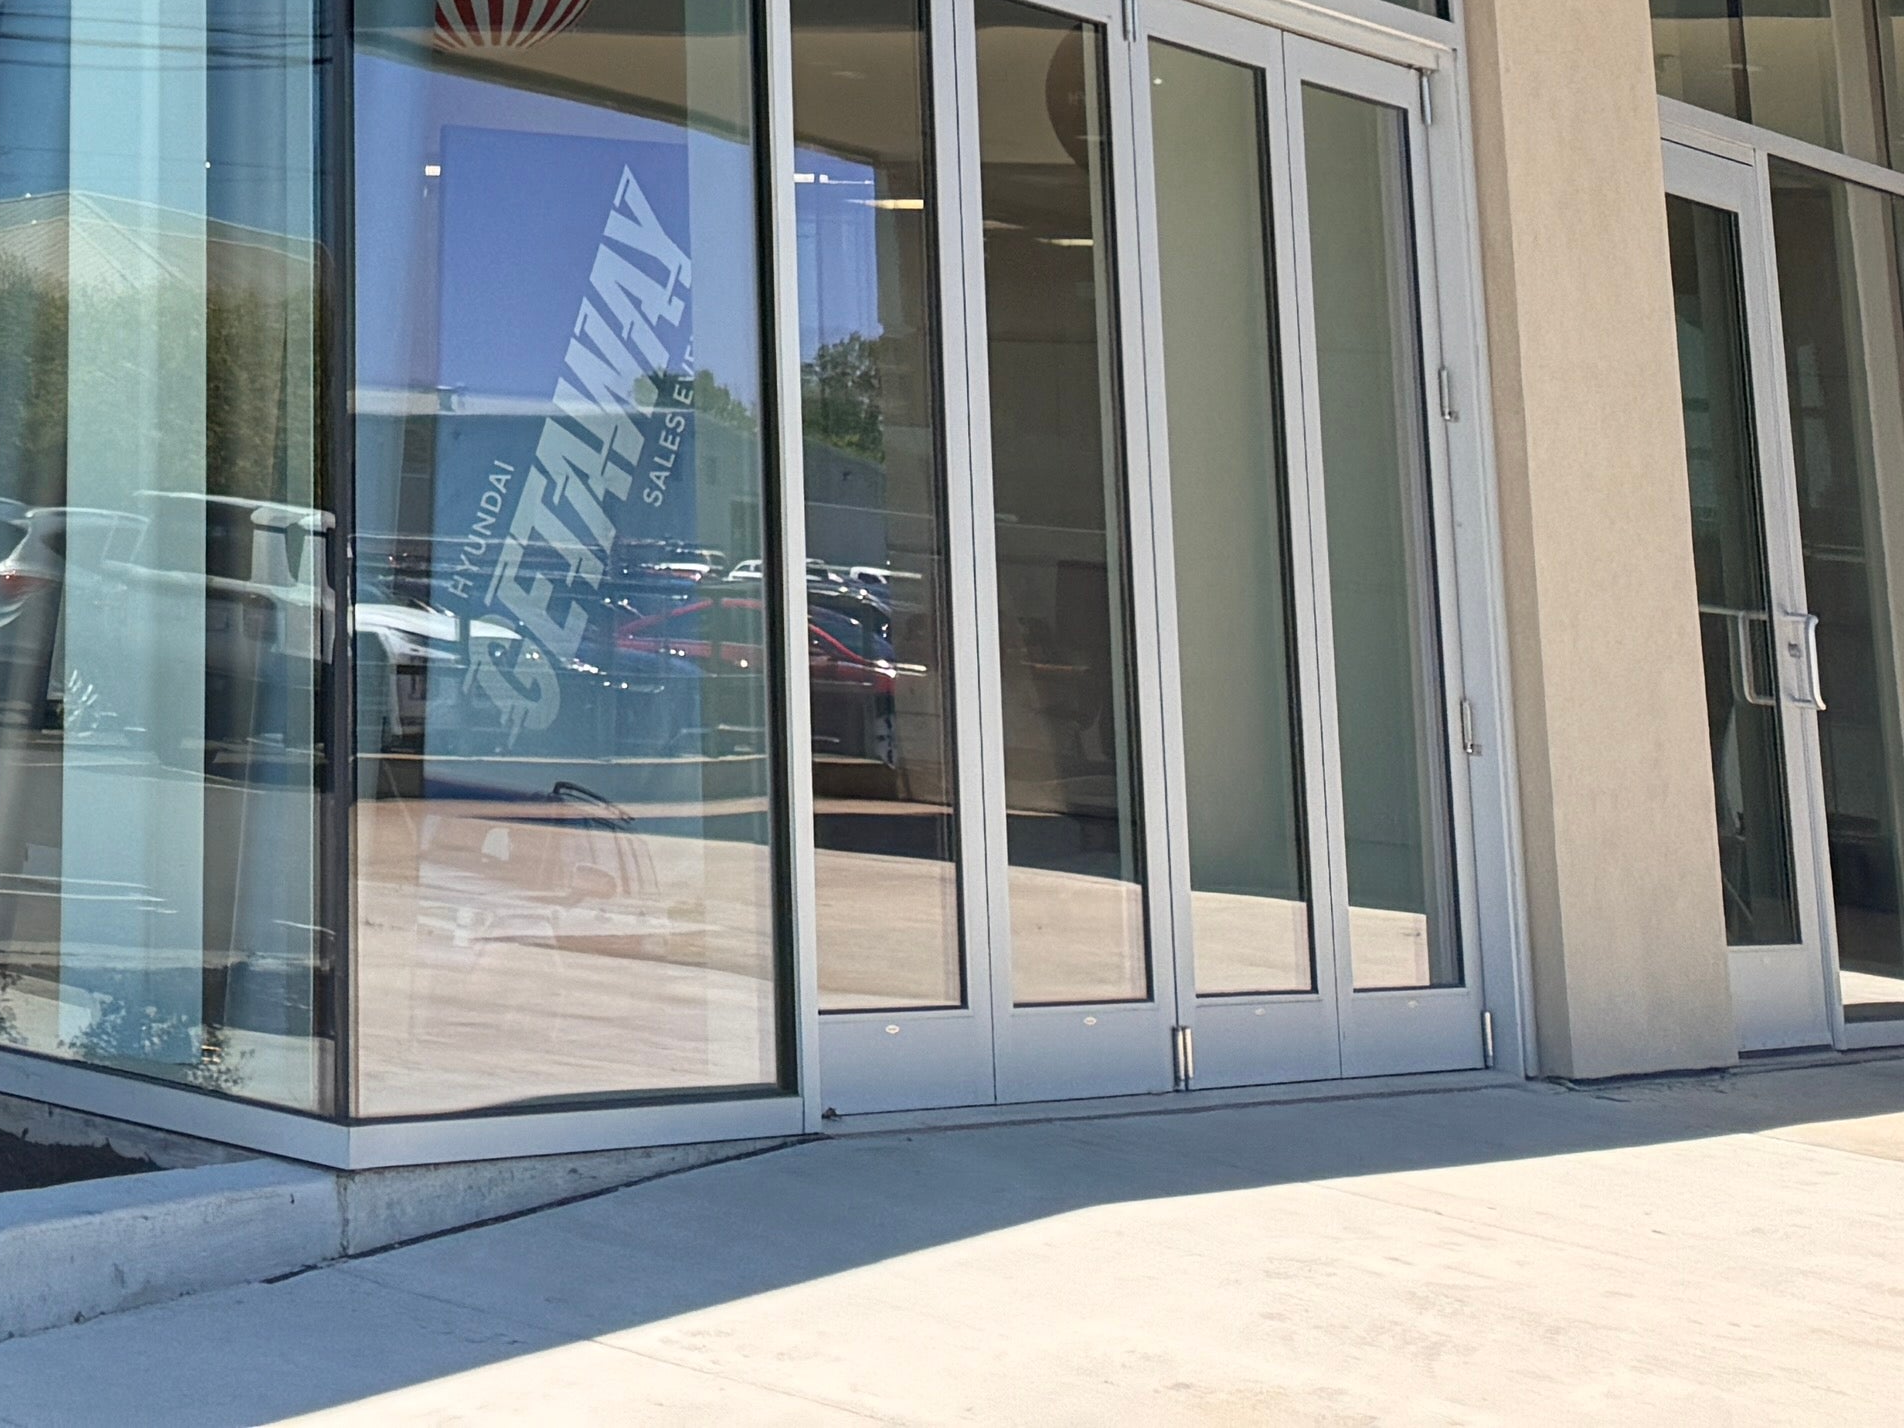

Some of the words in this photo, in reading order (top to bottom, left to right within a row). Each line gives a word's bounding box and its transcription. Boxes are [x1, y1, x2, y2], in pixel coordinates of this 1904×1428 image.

[462, 163, 693, 750] GETAWAY
[643, 412, 686, 507] SALES
[448, 460, 515, 599] HYUNDAI
